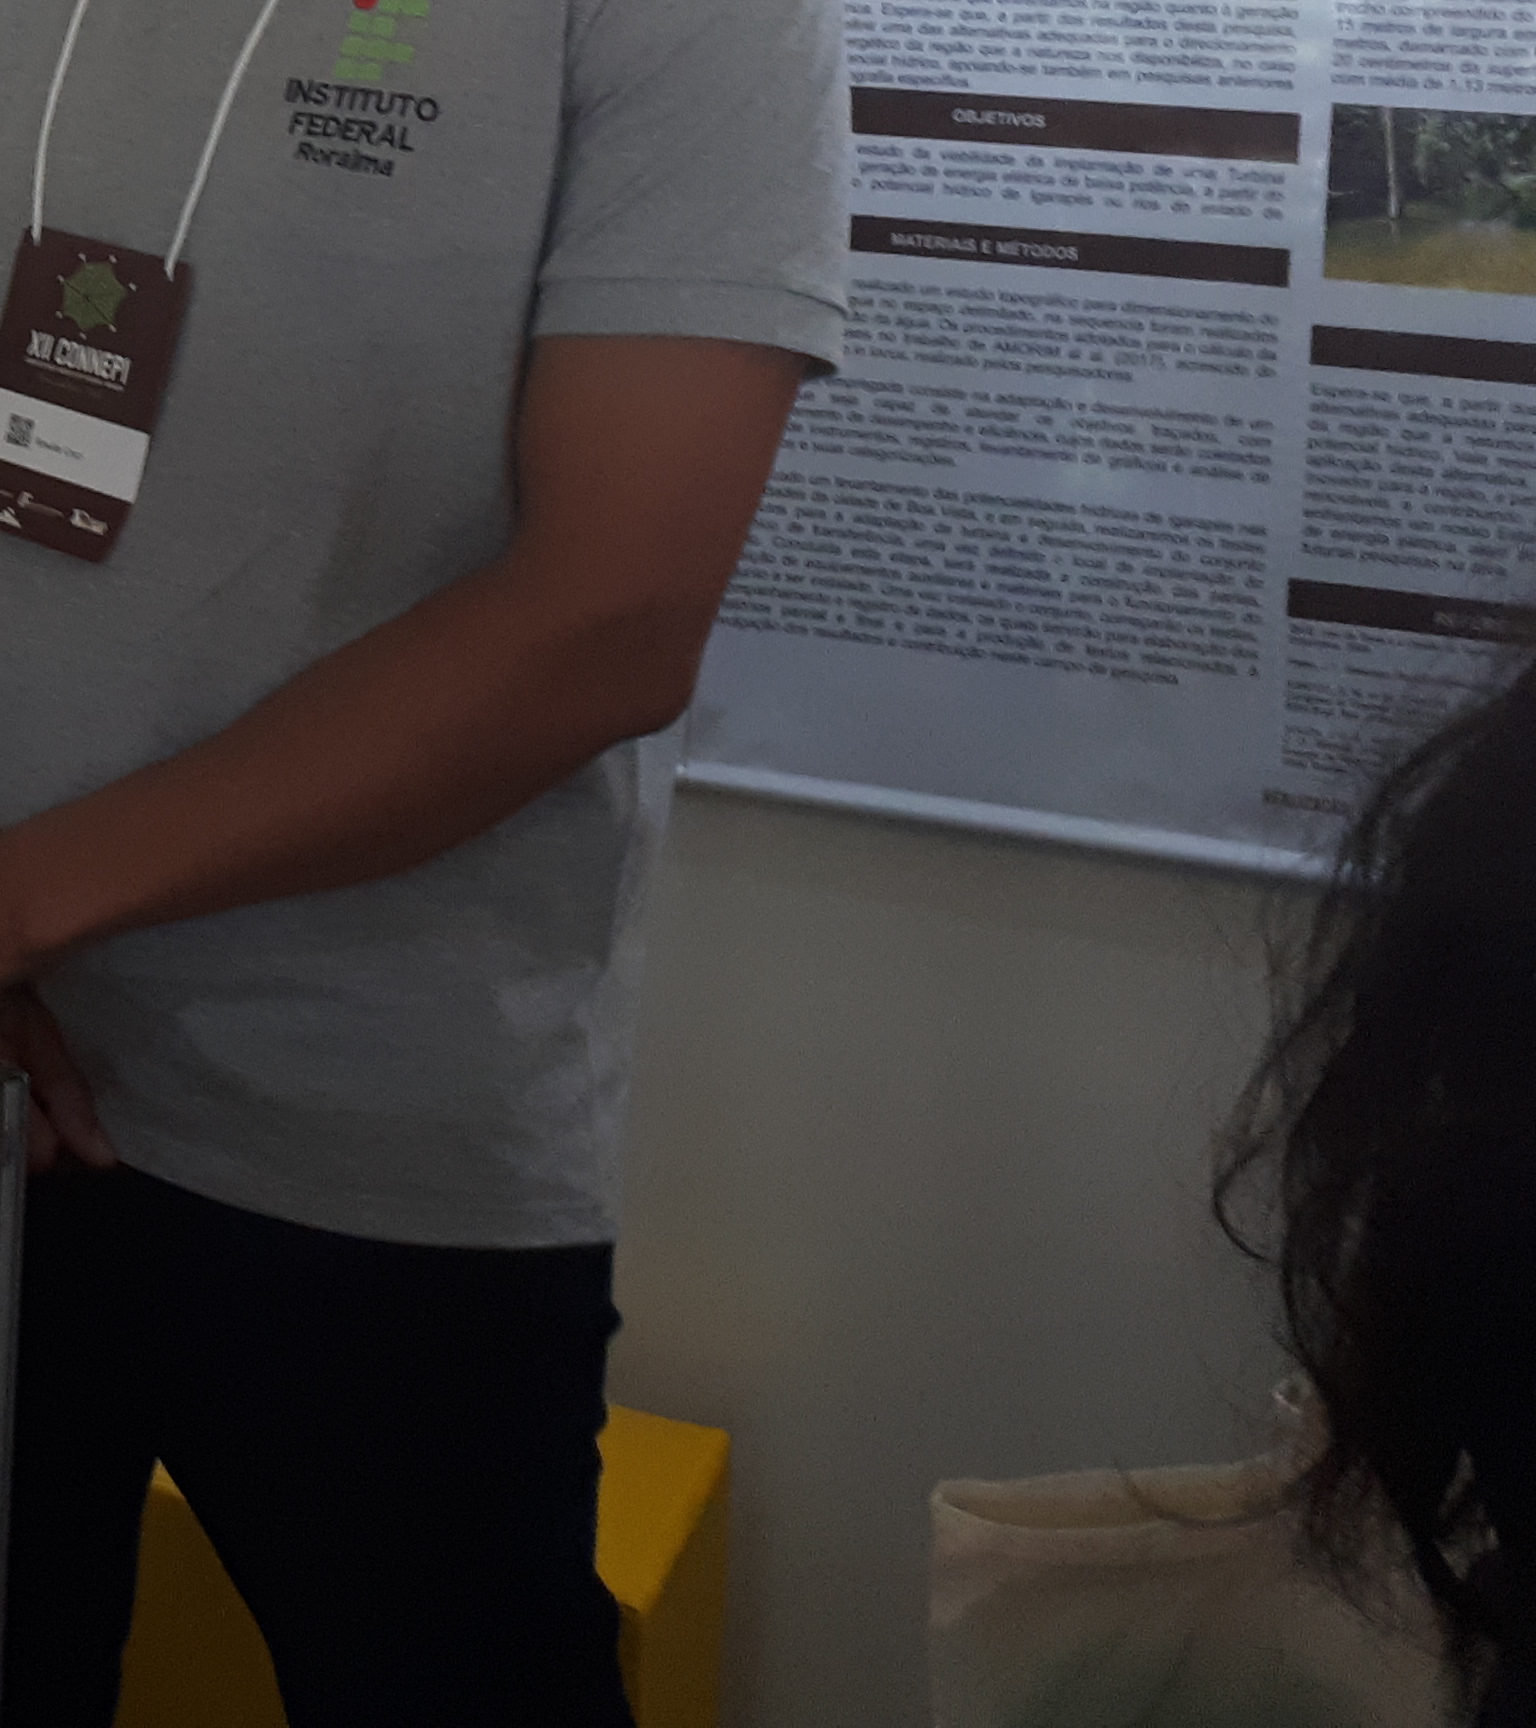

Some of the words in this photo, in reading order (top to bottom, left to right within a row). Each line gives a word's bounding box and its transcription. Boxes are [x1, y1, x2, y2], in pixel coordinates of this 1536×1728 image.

[284, 77, 440, 122] INSTITUTO
[951, 107, 1047, 129] OBJETIVOS
[288, 110, 415, 153] FEDERAL
[25, 329, 54, 361] XII
[54, 338, 132, 387] CONNEPI
